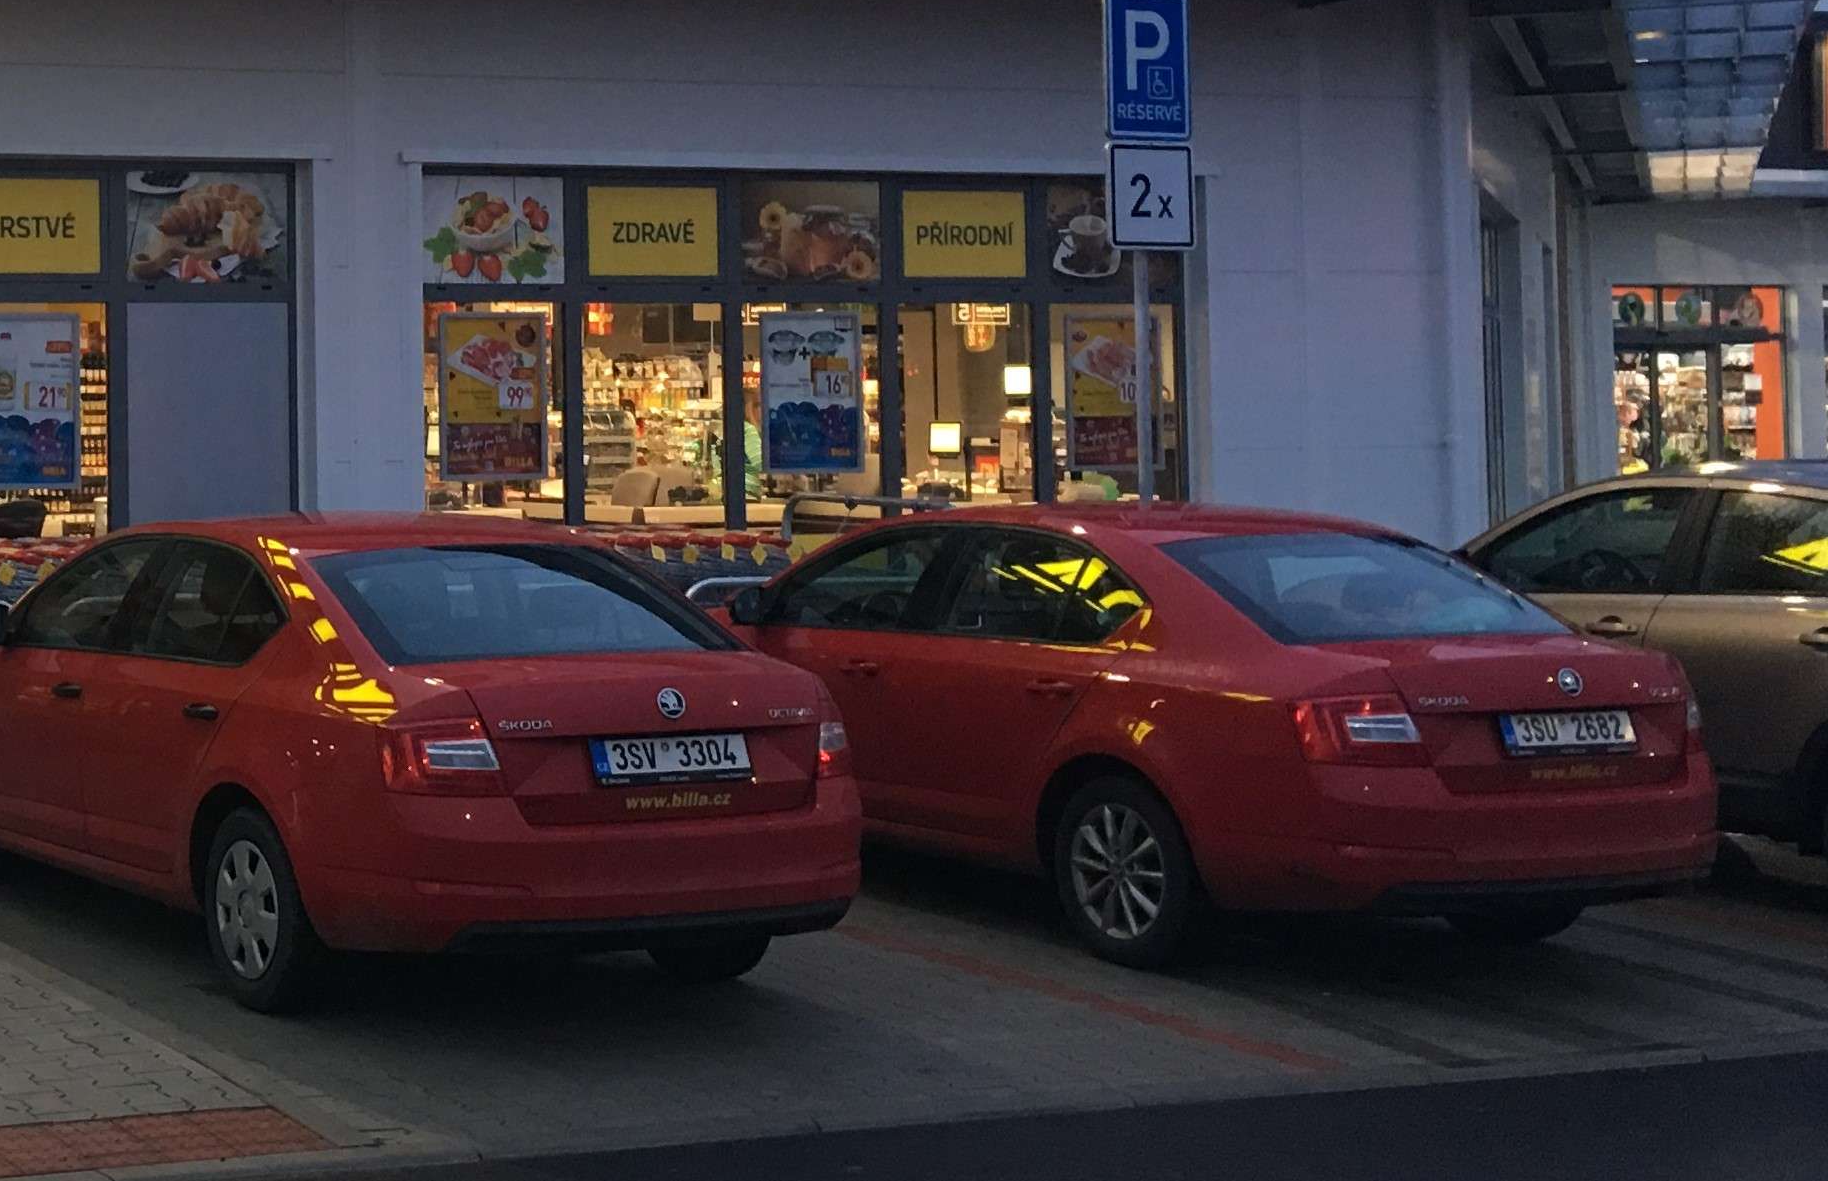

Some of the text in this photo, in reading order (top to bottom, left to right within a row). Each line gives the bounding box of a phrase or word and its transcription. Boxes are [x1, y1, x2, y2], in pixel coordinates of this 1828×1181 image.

[1124, 9, 1170, 91] P
[1116, 101, 1183, 122] RÉSERVÉ
[612, 218, 696, 244] ZDRAVÉ
[915, 221, 1014, 247] PŘÍRODNÍ
[1521, 713, 1626, 743] 3SU 2682
[611, 738, 737, 770] 3SV 3304
[625, 792, 732, 810] www.billa.cz
